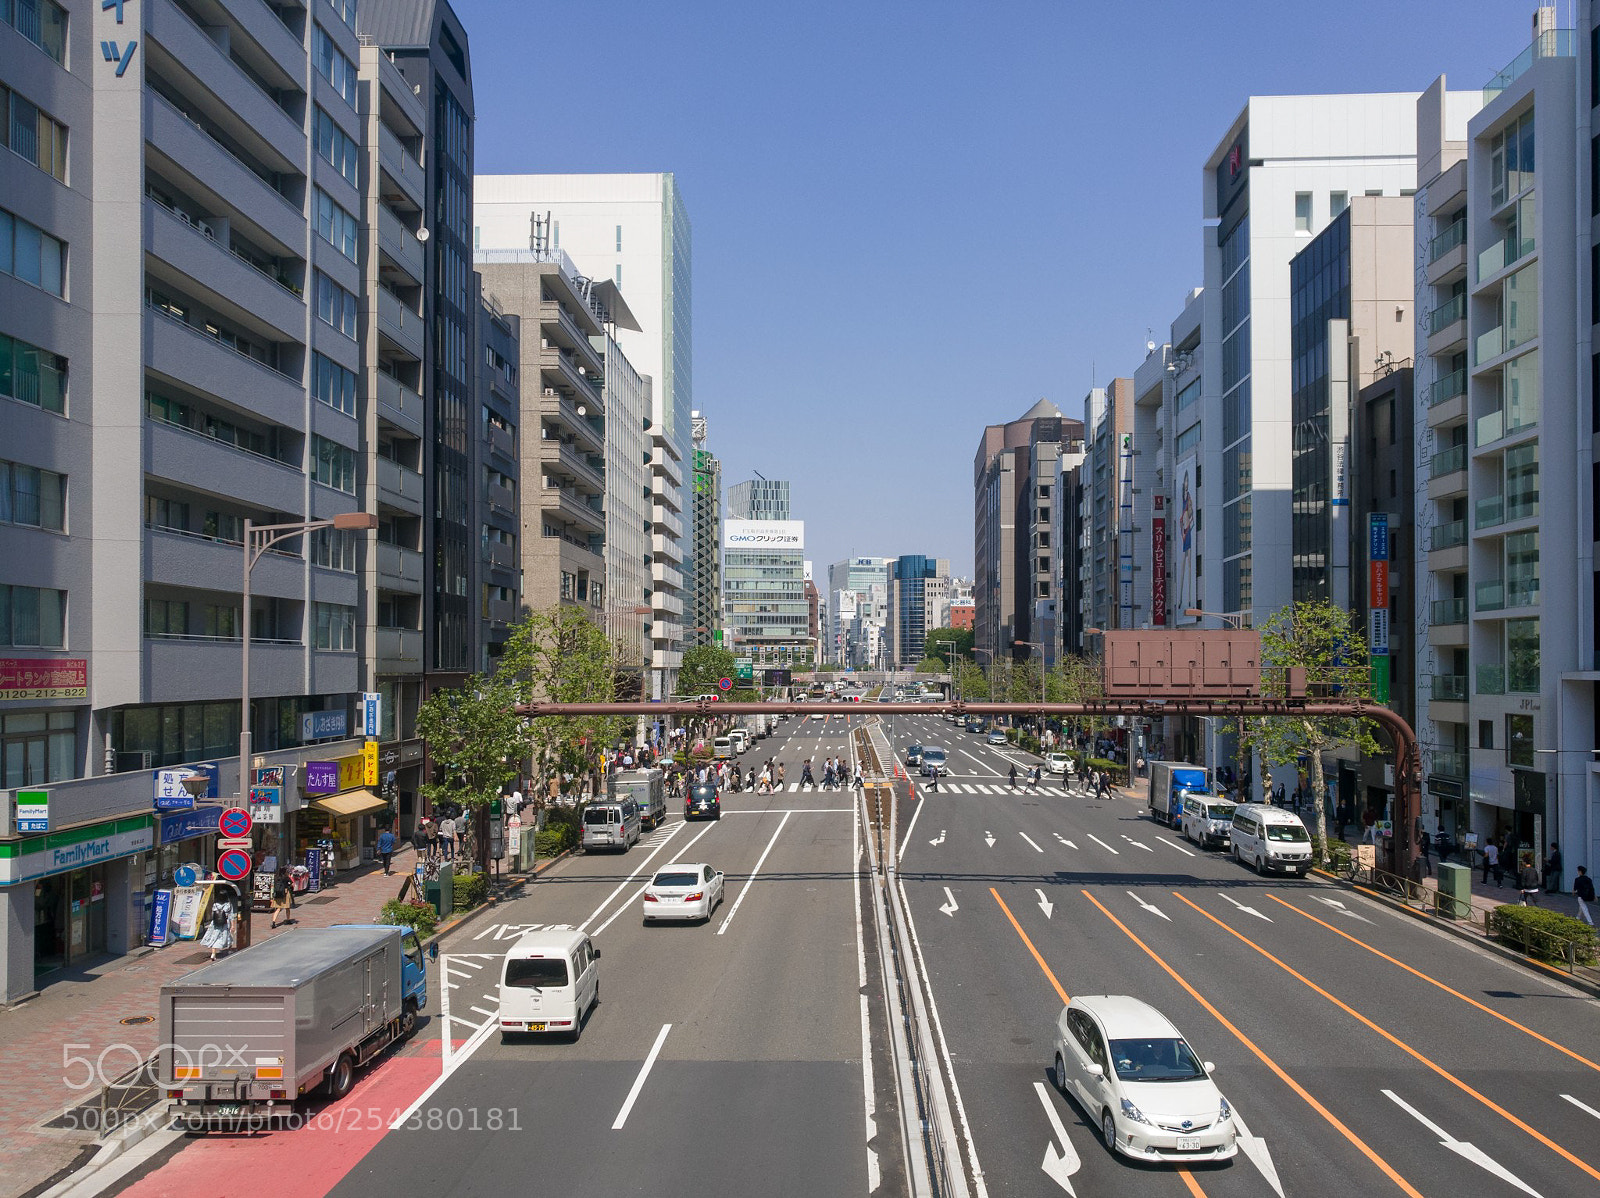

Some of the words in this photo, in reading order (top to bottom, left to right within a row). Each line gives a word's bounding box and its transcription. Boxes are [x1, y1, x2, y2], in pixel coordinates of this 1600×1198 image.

[729, 534, 799, 543] GMOクリック証券
[1155, 526, 1165, 617] スリムビューティハウス
[0, 688, 86, 699] 0120-212-822
[314, 714, 345, 733] しおざき内科
[307, 772, 337, 788] たんす屋
[30, 822, 46, 830] たばこ
[53, 839, 110, 867] FamilyMart
